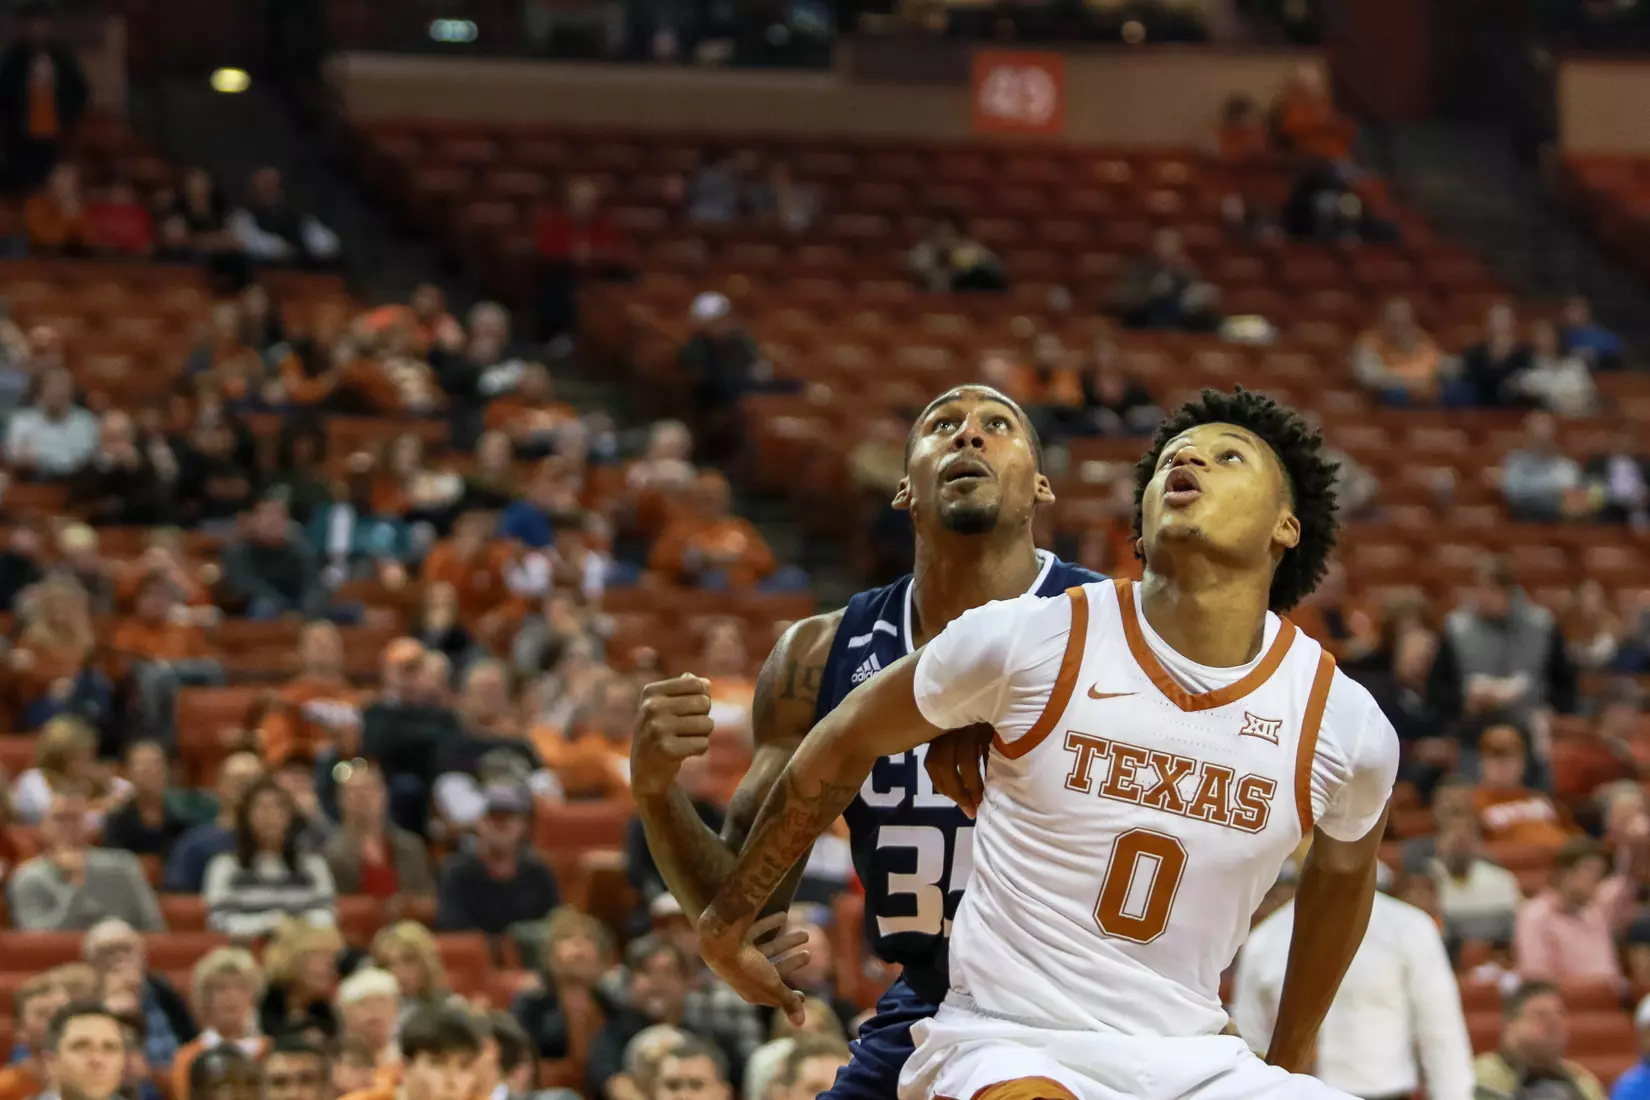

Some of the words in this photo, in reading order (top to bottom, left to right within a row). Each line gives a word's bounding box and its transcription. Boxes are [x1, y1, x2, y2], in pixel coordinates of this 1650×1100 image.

[851, 669, 881, 683] adid
[1239, 711, 1283, 746] XII
[1064, 729, 1278, 835] TEXAS
[1092, 826, 1189, 945] 0
